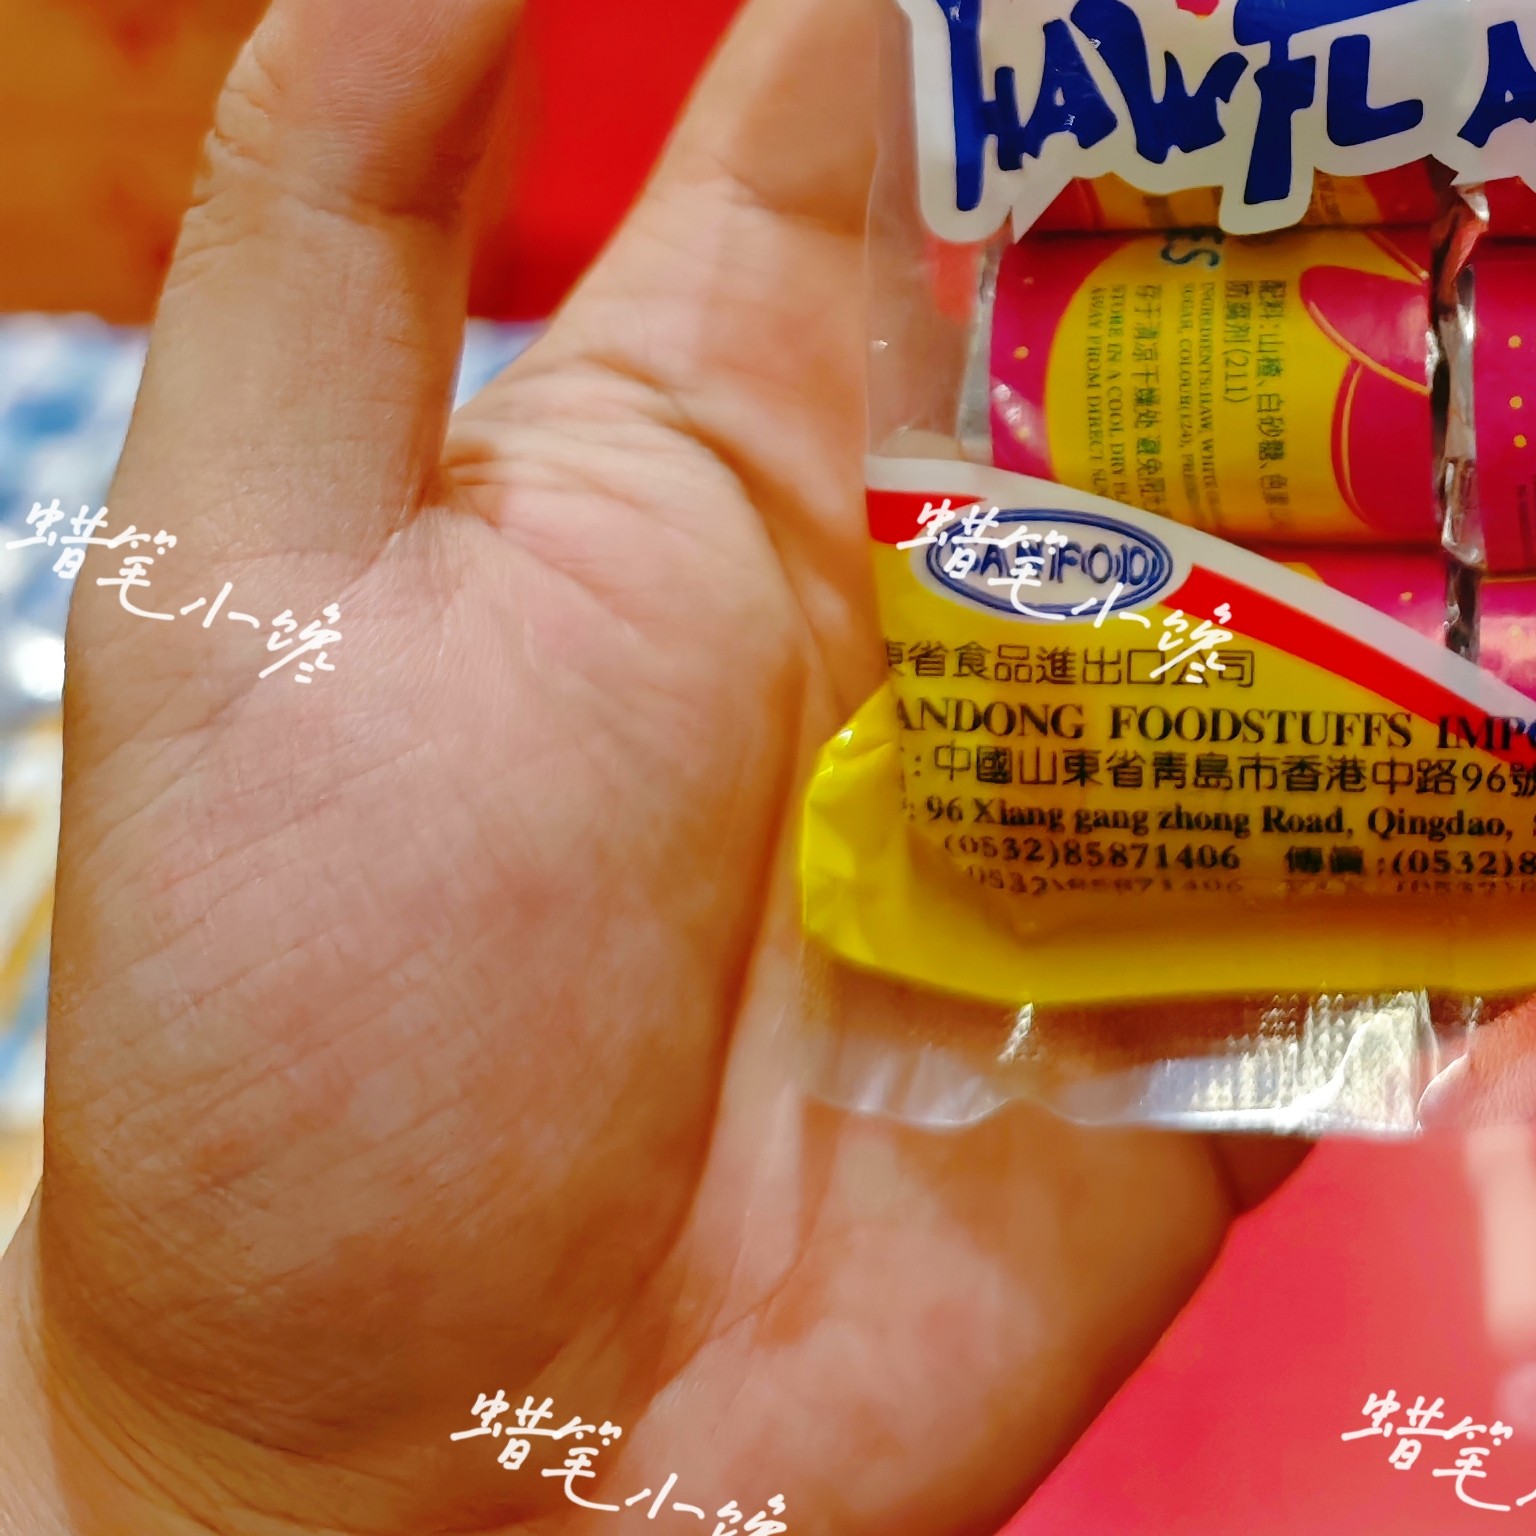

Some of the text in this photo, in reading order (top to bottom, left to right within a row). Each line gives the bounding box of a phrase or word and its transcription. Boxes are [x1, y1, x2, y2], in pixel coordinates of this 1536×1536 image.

[1109, 704, 1413, 749] FOODSTUFFS
[925, 794, 964, 824] 96
[973, 796, 1066, 834] Xiang
[1075, 806, 1149, 836] gang
[1157, 801, 1251, 840] zhong
[1261, 804, 1354, 840] Road,
[1367, 805, 1514, 843] Qingdao,
[944, 834, 1242, 872] (0532)85871406
